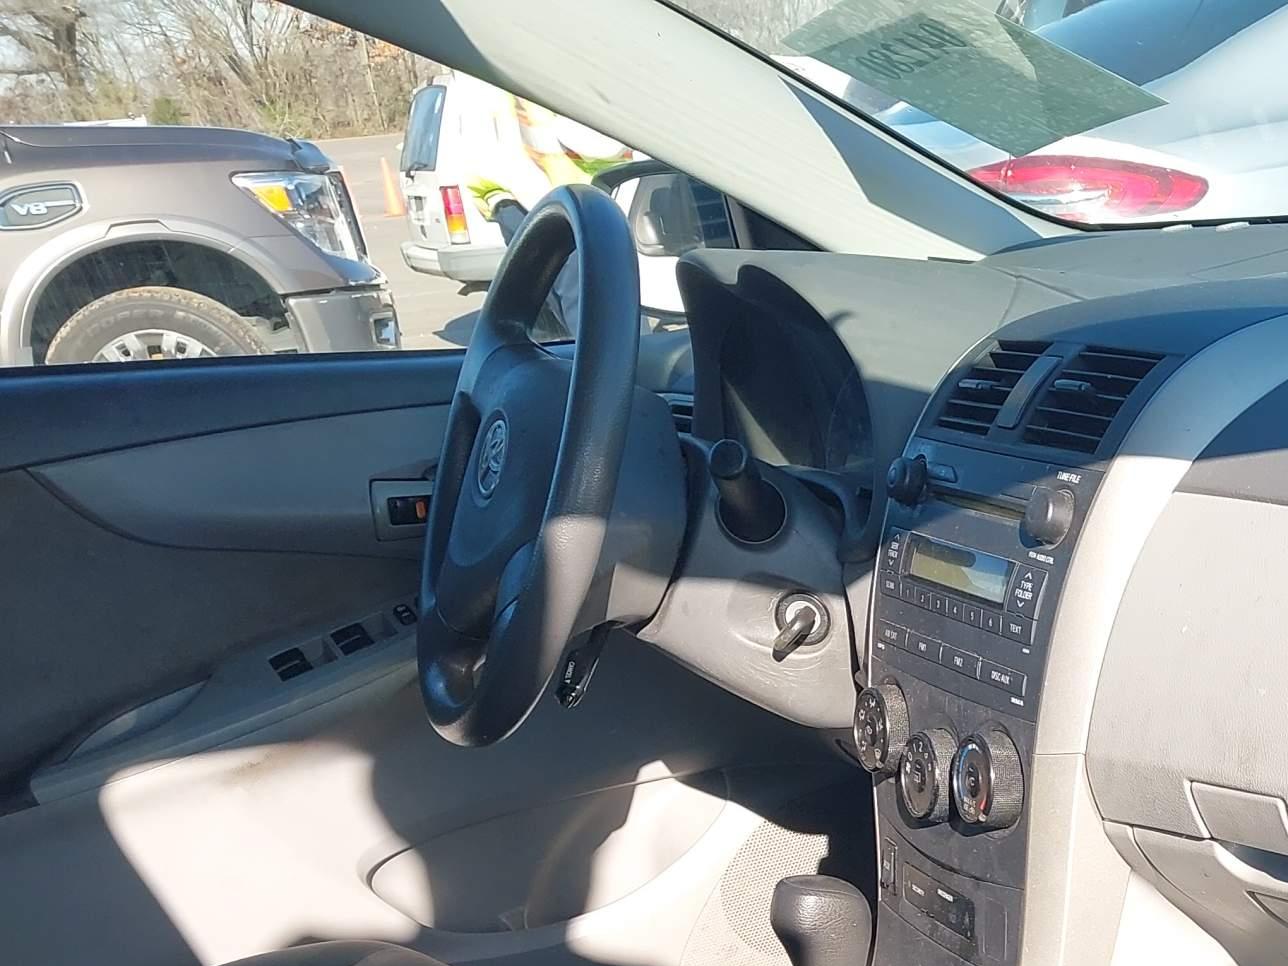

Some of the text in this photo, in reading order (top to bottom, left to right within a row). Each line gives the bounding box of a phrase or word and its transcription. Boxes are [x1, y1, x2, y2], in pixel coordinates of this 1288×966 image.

[11, 201, 49, 216] V8
[1020, 580, 1034, 592] TYPE
[1014, 588, 1033, 601] FOLDER
[1009, 623, 1022, 635] TEXT
